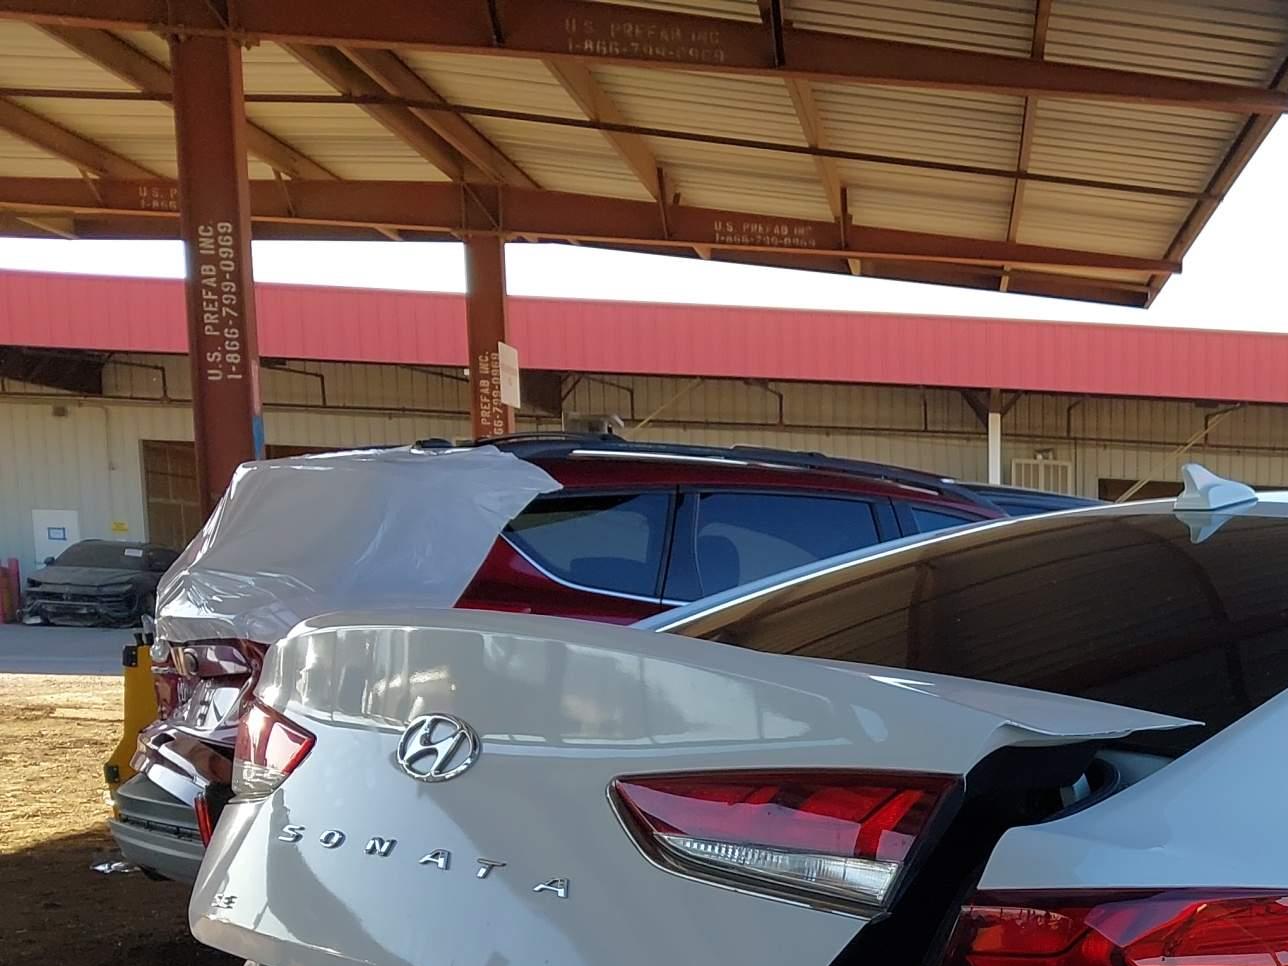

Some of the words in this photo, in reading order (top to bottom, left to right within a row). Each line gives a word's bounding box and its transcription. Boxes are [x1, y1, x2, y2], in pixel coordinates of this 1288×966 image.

[200, 264, 221, 336] PREFAB
[217, 221, 243, 380] 1-866-799-0969
[207, 346, 224, 381] U.S.
[479, 379, 492, 426] PREFAB
[277, 824, 570, 899] SONATA
